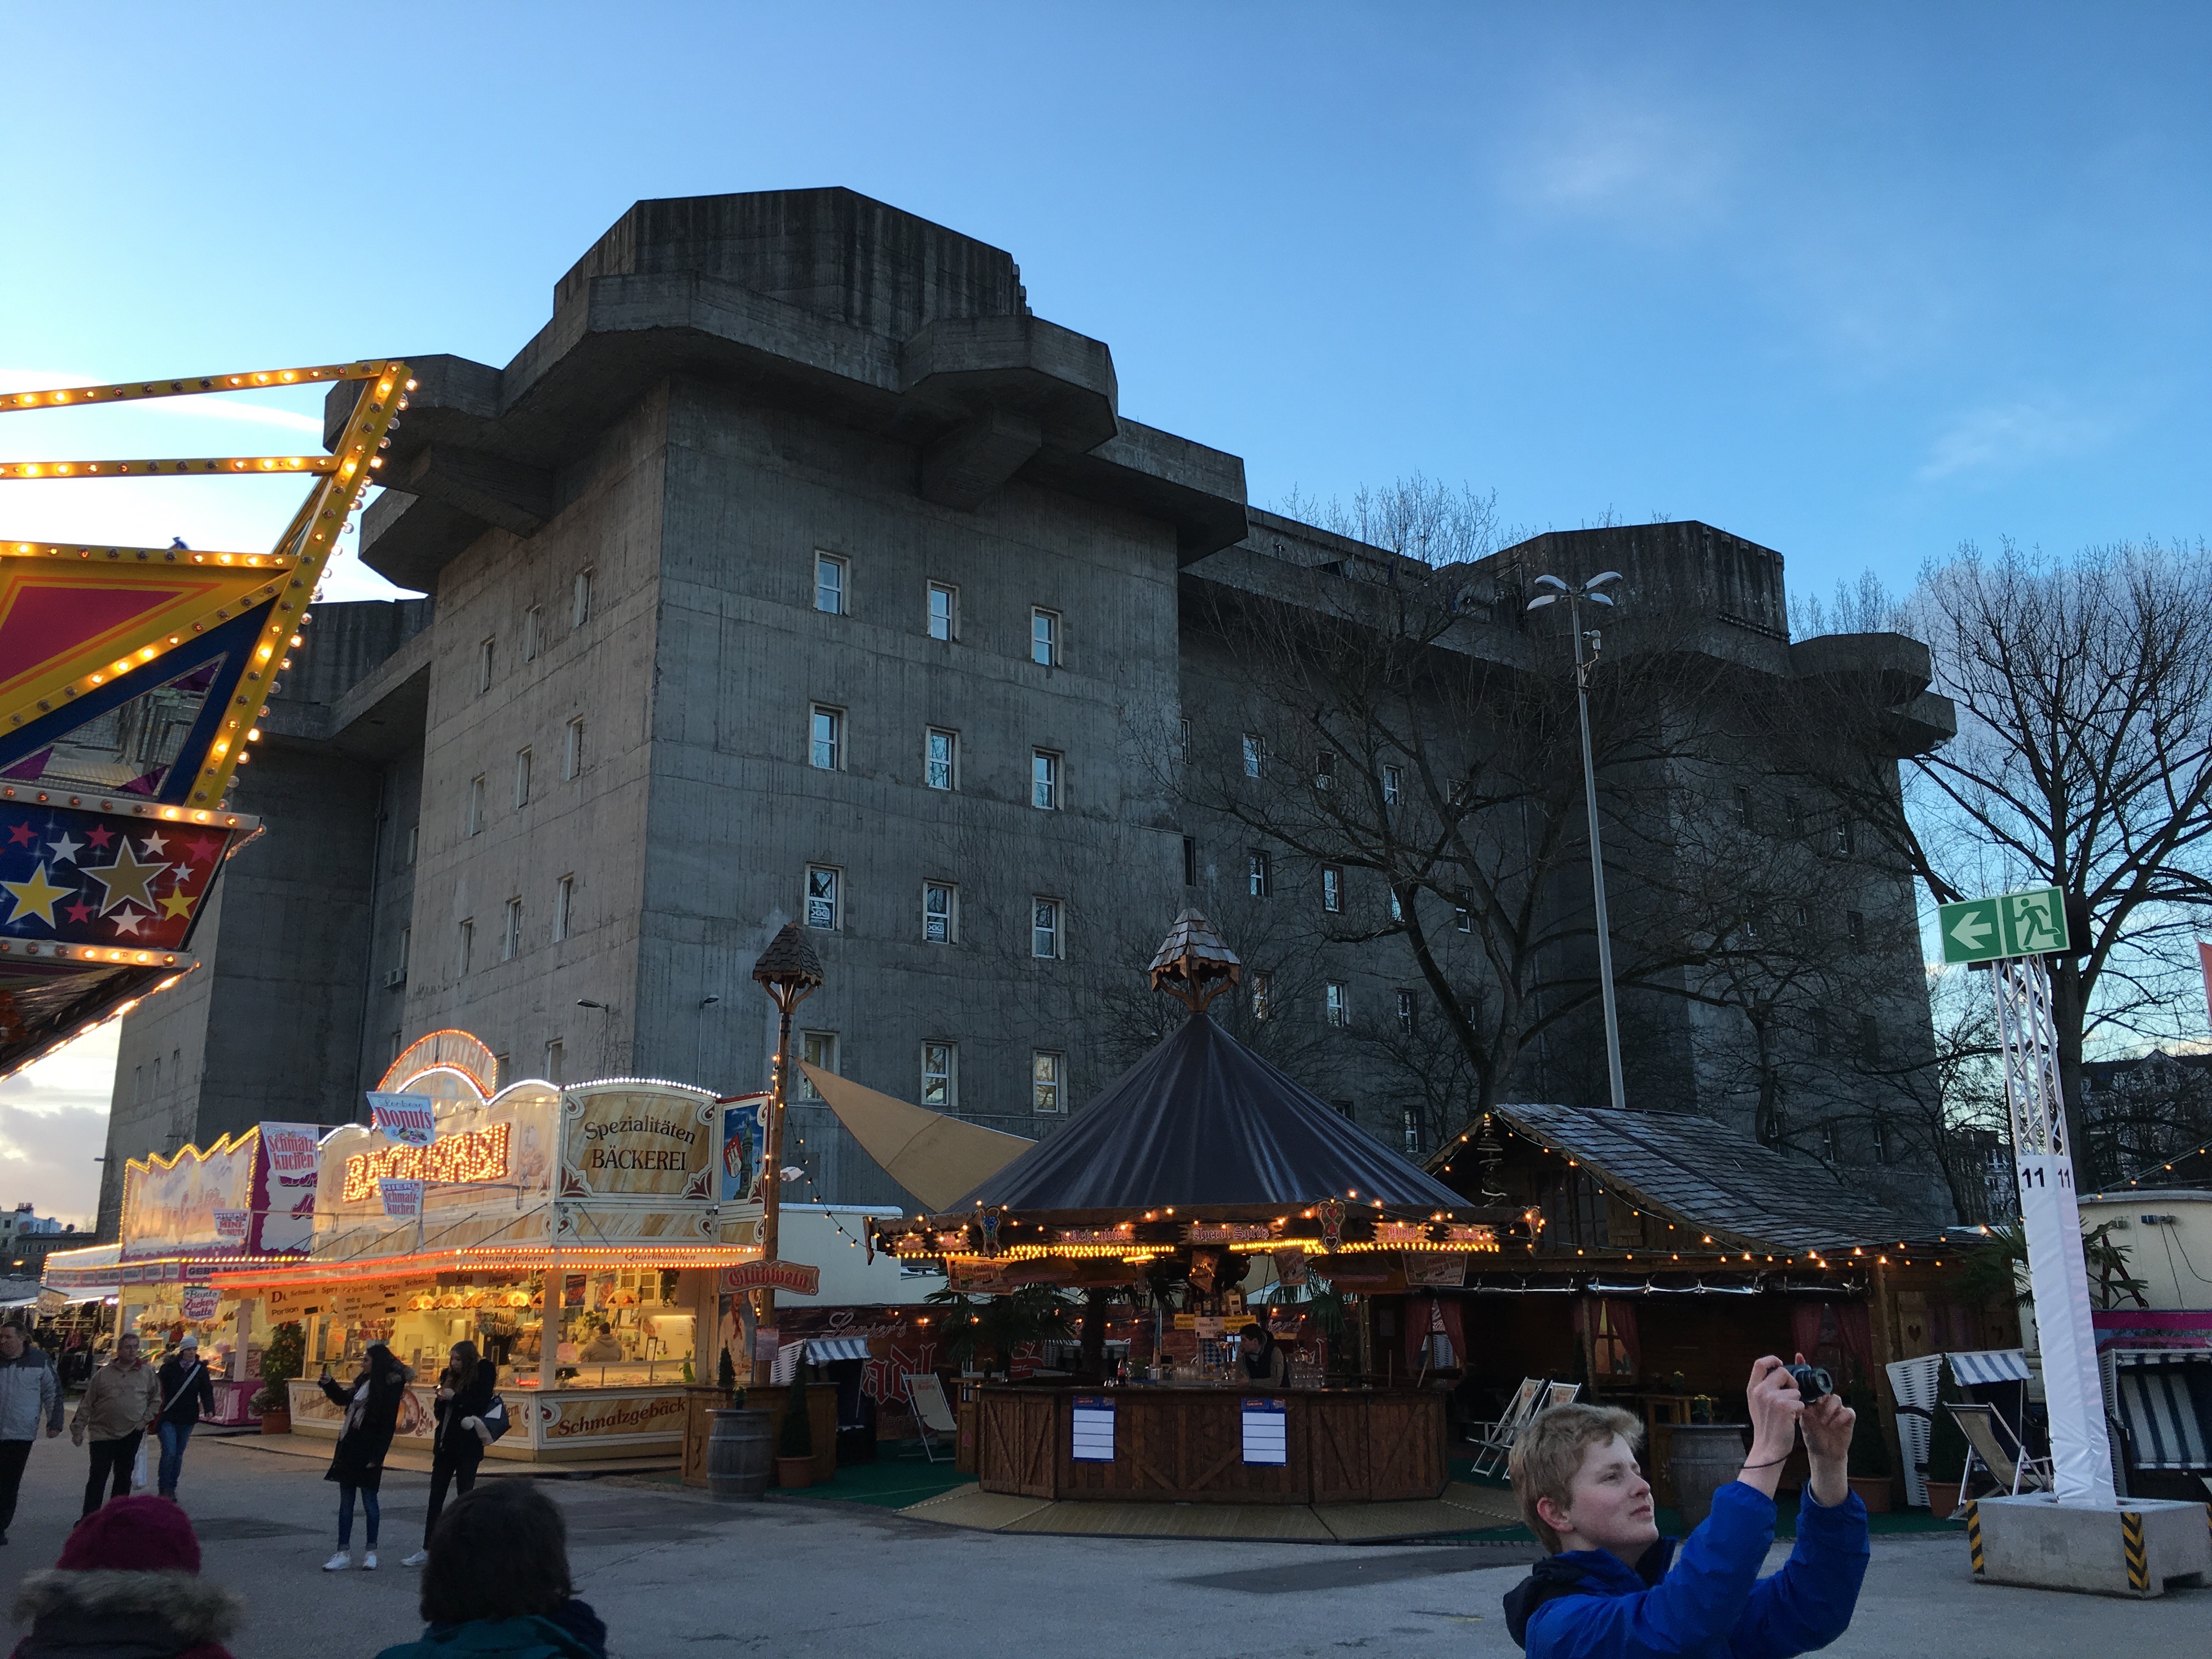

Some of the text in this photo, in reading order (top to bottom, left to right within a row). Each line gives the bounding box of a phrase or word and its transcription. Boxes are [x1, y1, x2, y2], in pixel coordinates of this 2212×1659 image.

[375, 1107, 432, 1129] Donuts
[584, 1115, 696, 1145] Spezialitäten
[267, 1135, 316, 1152] Schmalz-
[273, 1153, 314, 1170] kuchen
[591, 1144, 686, 1171] BÄCKEREI
[2022, 1167, 2045, 1188] 11
[2057, 1168, 2071, 1189] 11
[383, 1190, 419, 1203] Schmalz-
[387, 1203, 415, 1215] kuchen
[1192, 1226, 1269, 1242] Aperol Spritz
[728, 1266, 810, 1288] Glühwein
[272, 1306, 299, 1316] Portion
[557, 1396, 686, 1437] Schmalzgebäck
